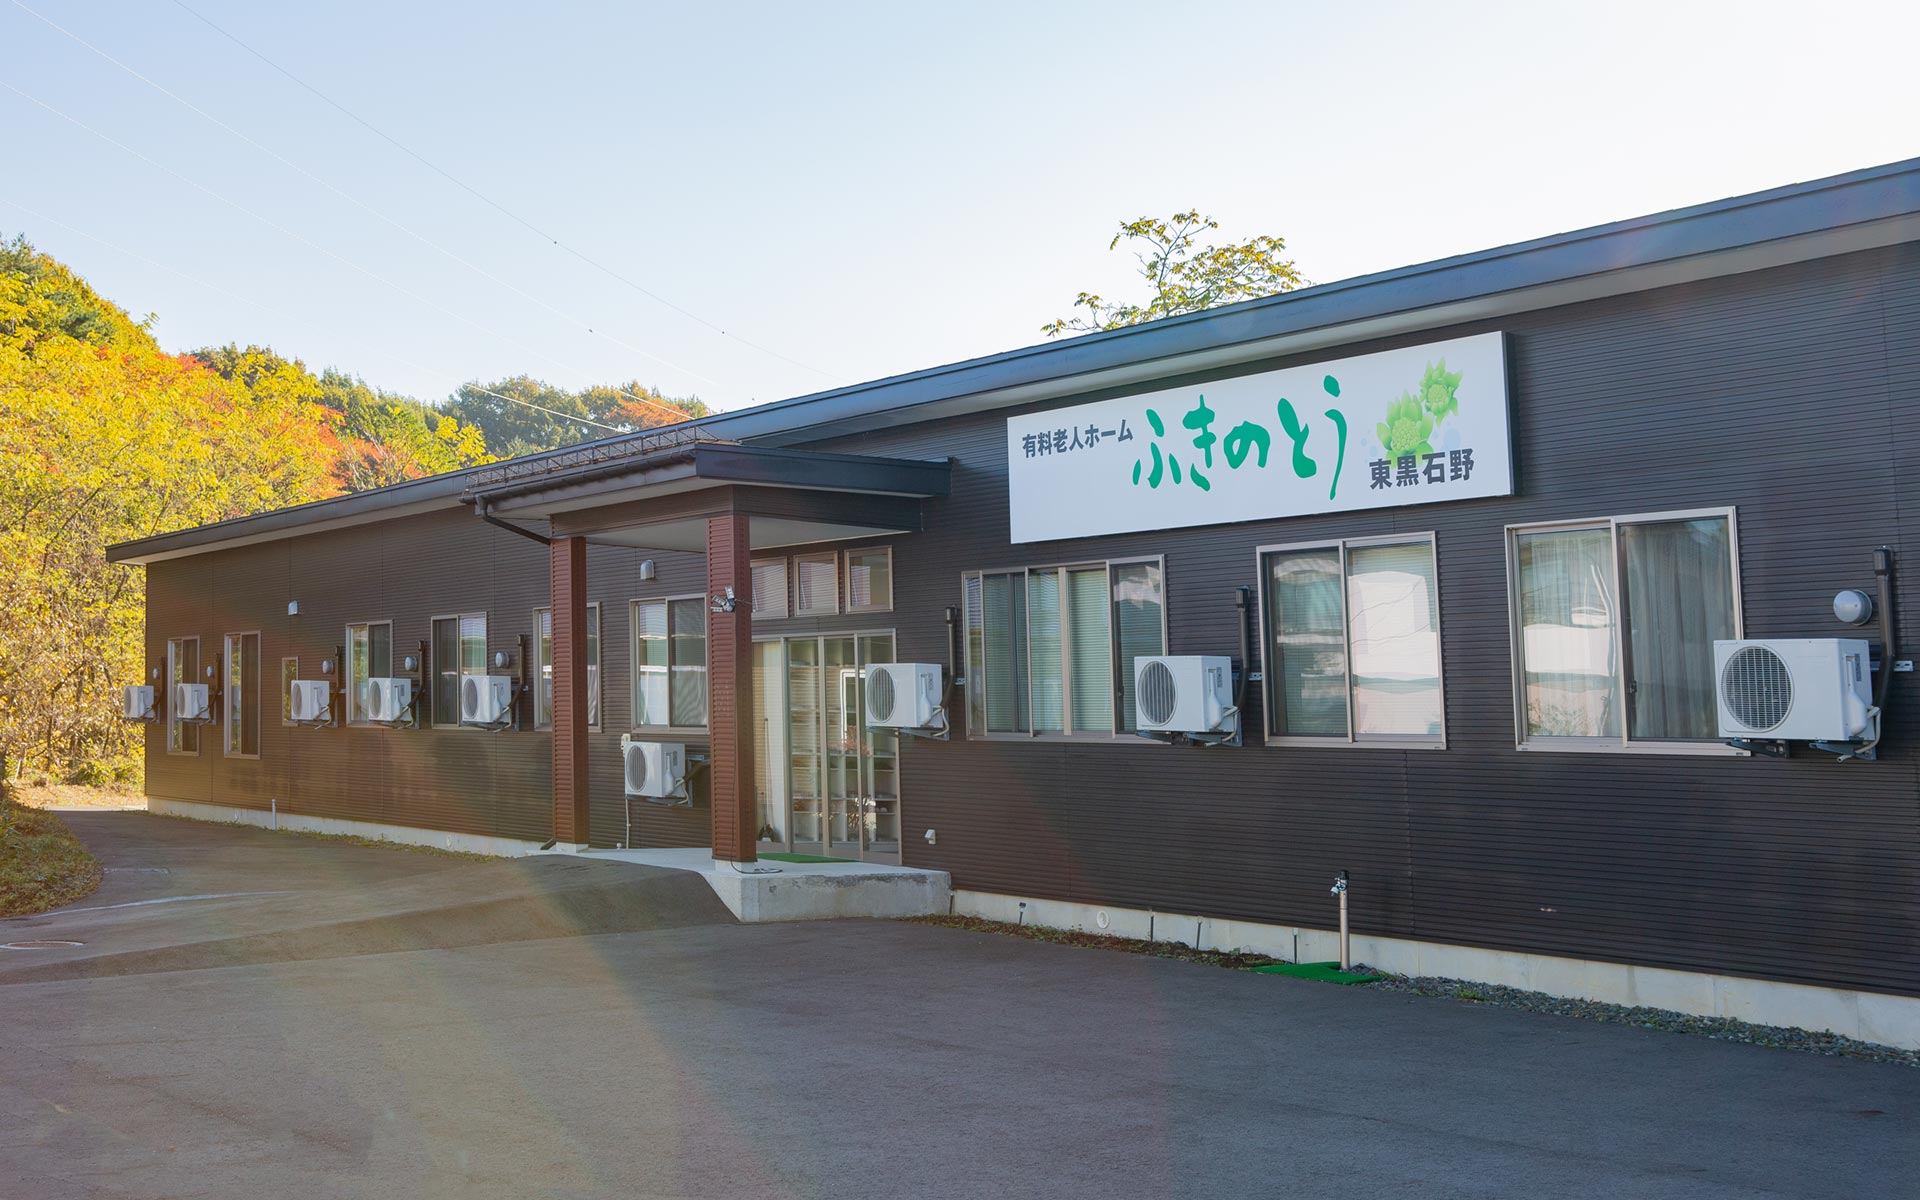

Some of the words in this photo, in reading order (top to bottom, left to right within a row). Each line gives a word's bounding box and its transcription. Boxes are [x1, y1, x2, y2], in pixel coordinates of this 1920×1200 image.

[1022, 419, 1134, 458] 有料老人ホーム
[1132, 375, 1347, 500] ふきのとう
[1369, 447, 1475, 490] 東黒石野
